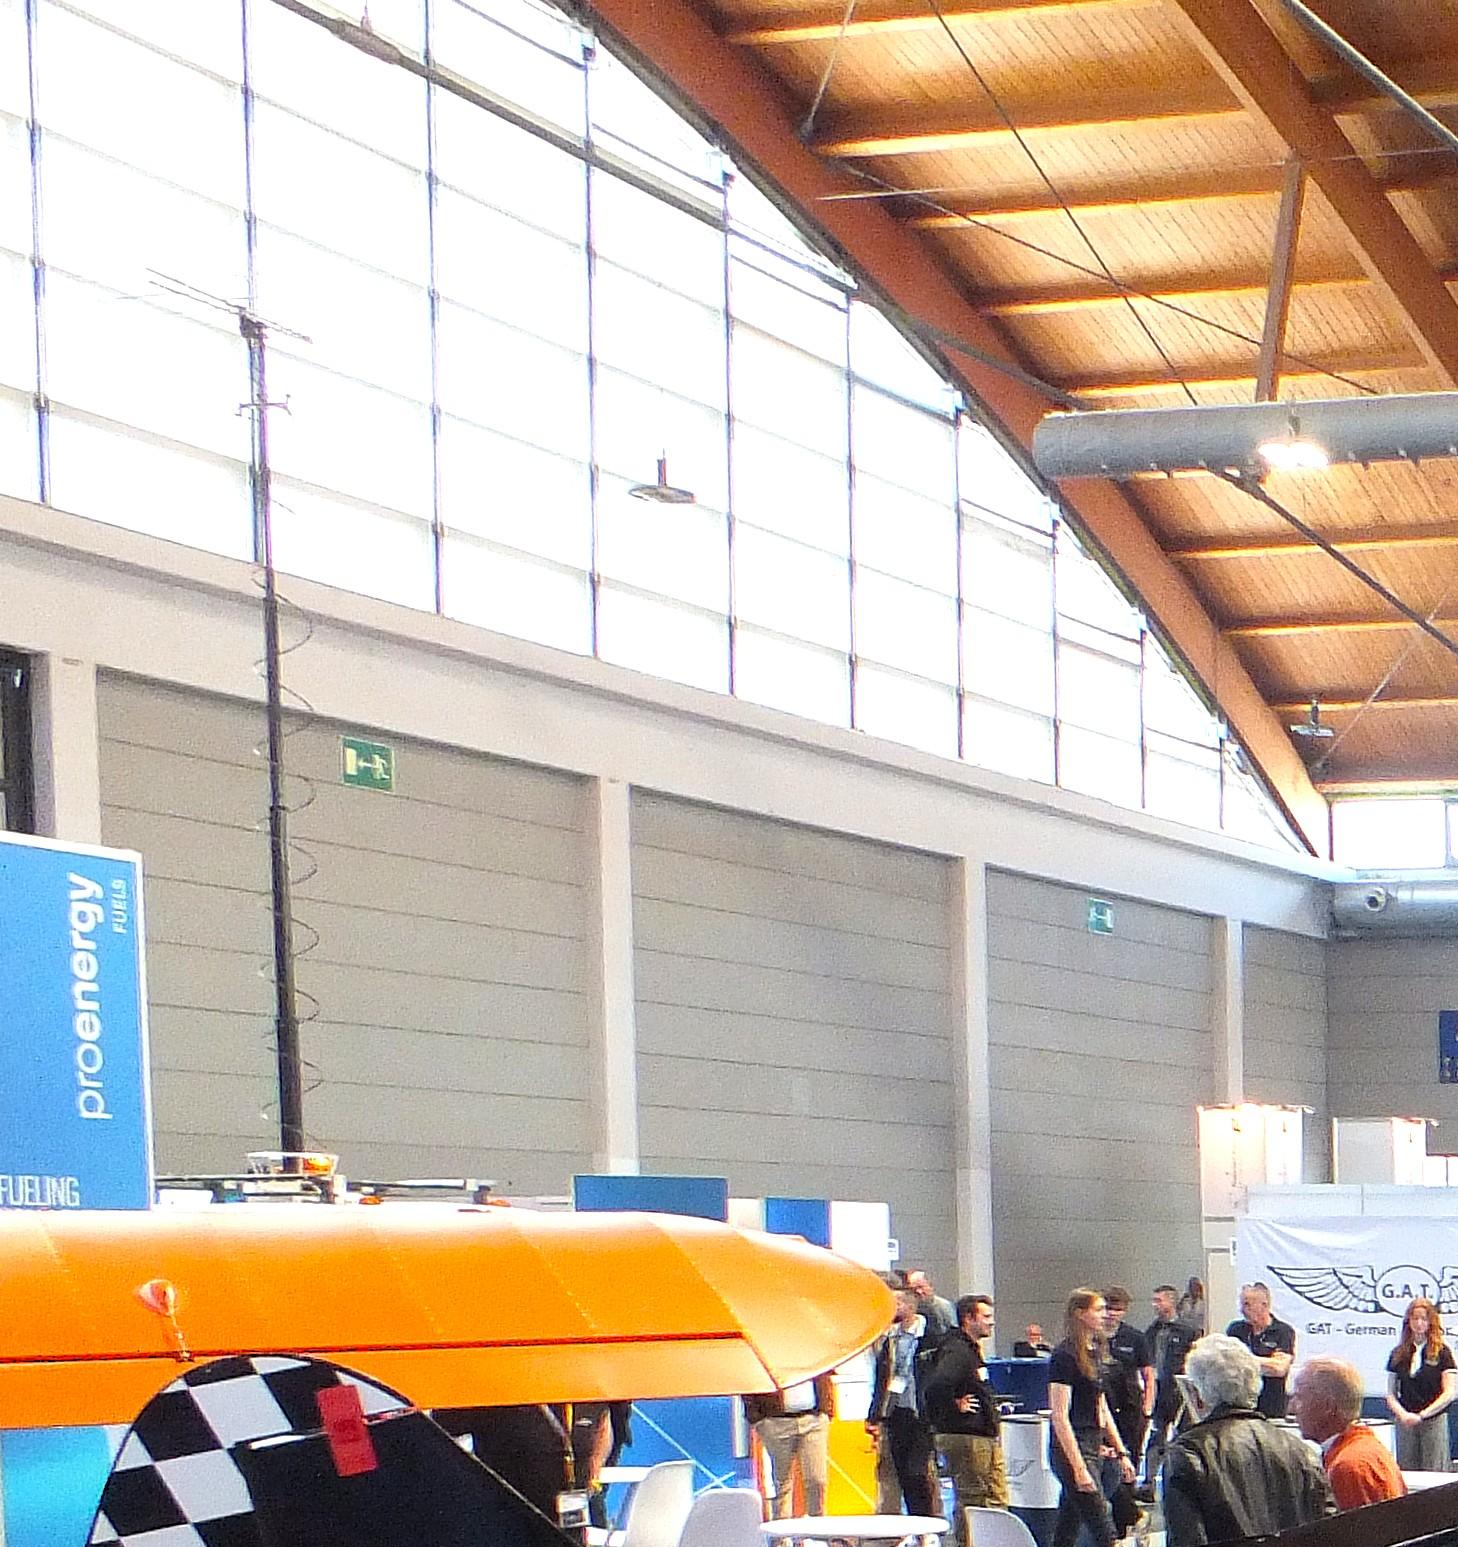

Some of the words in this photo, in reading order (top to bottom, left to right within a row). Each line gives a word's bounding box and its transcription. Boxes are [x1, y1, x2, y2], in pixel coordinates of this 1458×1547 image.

[67, 870, 113, 1120] proenergy
[1382, 1283, 1433, 1299] G.A.T.
[1306, 1322, 1332, 1335] GAT
[1345, 1322, 1396, 1336] German
